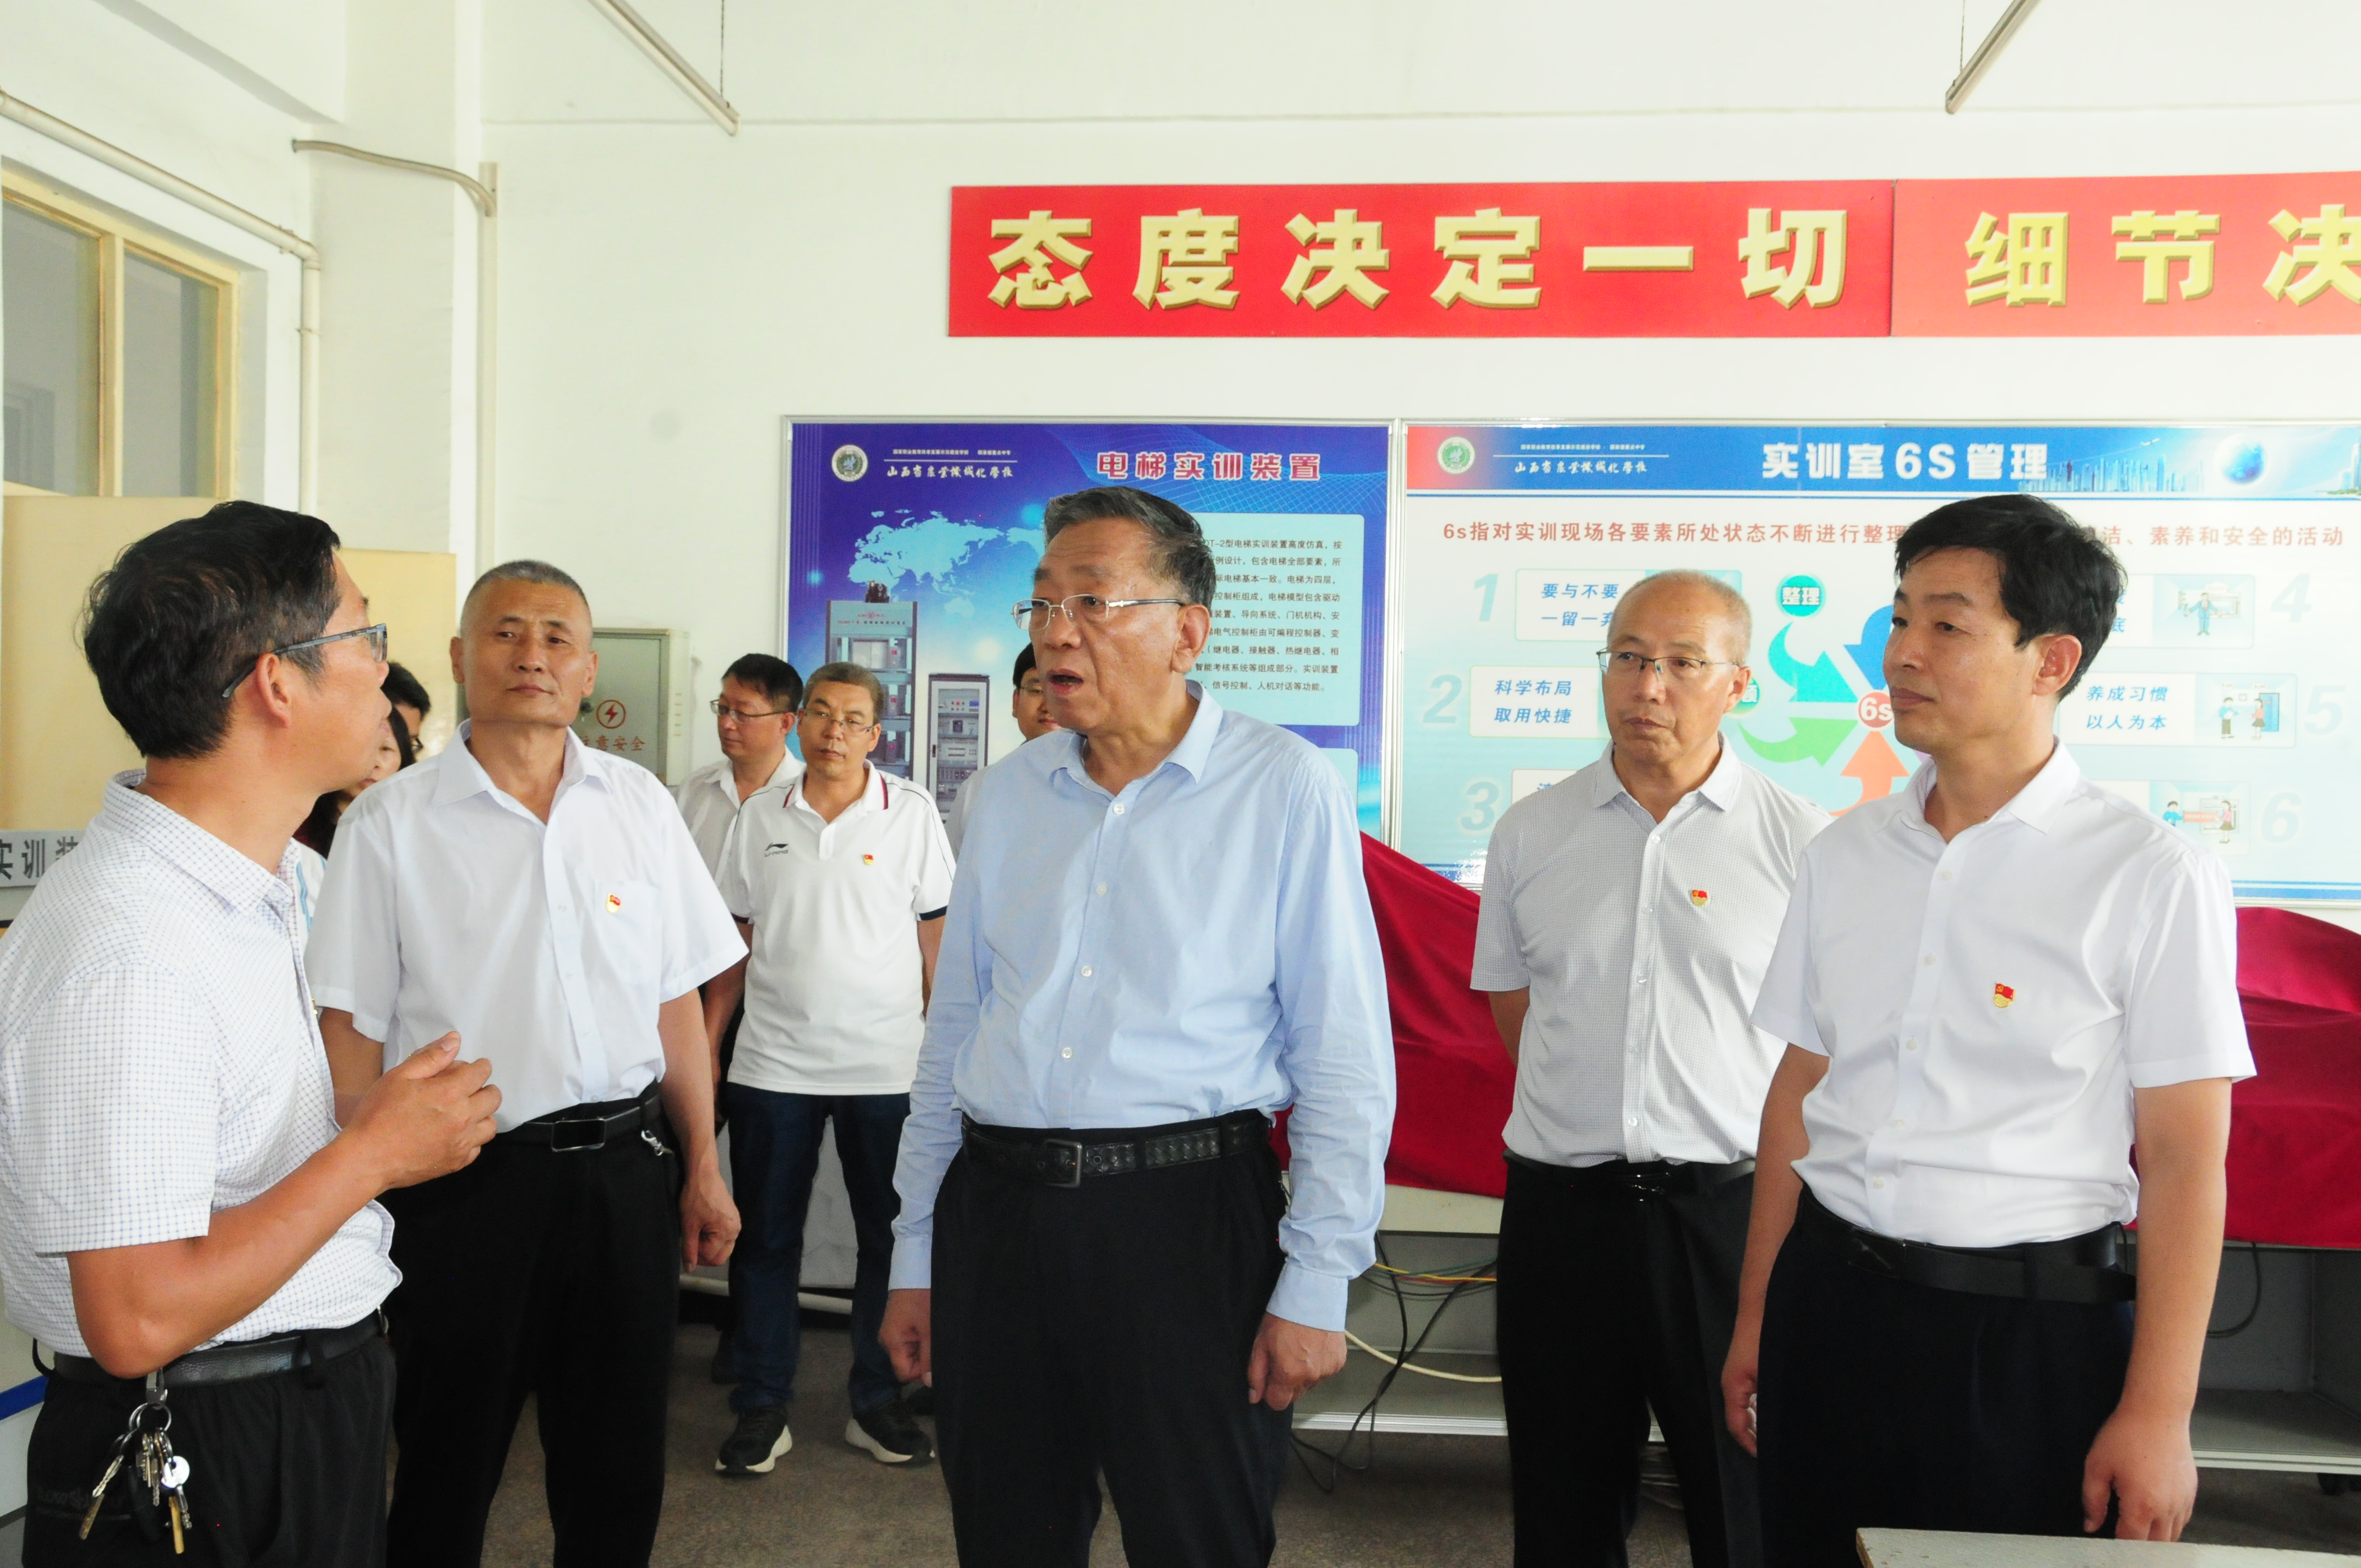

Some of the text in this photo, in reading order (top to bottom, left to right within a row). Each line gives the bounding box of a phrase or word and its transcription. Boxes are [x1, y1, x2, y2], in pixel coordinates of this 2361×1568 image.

[987, 205, 2361, 309] 态度决定一切 细节决
[1097, 451, 1321, 481] 电梯实训装置
[1762, 442, 2047, 480] 实训室6S管理
[2090, 525, 2343, 547] 洁、素养和安全的活动
[1473, 574, 1499, 622] 1
[1541, 584, 1619, 599] 要与不要
[1782, 586, 1820, 606] 整理
[2271, 573, 2312, 623] 4
[1210, 610, 1340, 620] 装置、导向系统、门机机构、安
[1423, 674, 1462, 723] 2
[1494, 680, 1572, 696] 科学布局
[2086, 685, 2168, 702] 养成习惯
[1494, 707, 1572, 723] 取用快捷
[2086, 714, 2167, 730] 以人为本
[2304, 685, 2346, 736] 5
[1460, 781, 1499, 831] 3
[2261, 792, 2302, 843] 6
